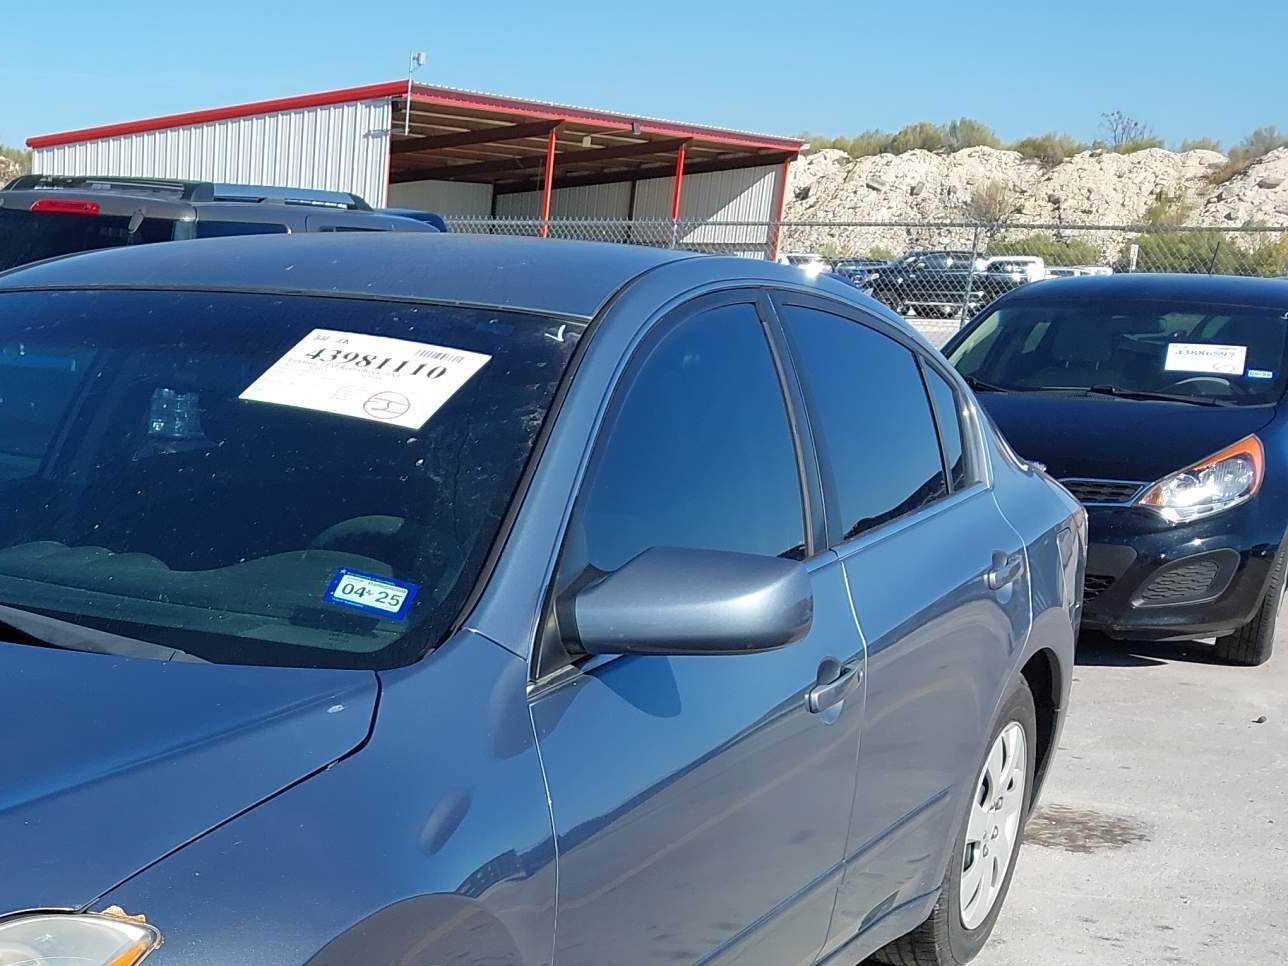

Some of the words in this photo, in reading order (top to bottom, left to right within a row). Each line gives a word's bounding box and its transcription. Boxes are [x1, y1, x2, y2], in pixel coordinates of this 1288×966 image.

[305, 347, 447, 380] 43981110
[341, 583, 367, 598] 04
[374, 591, 403, 607] 25
